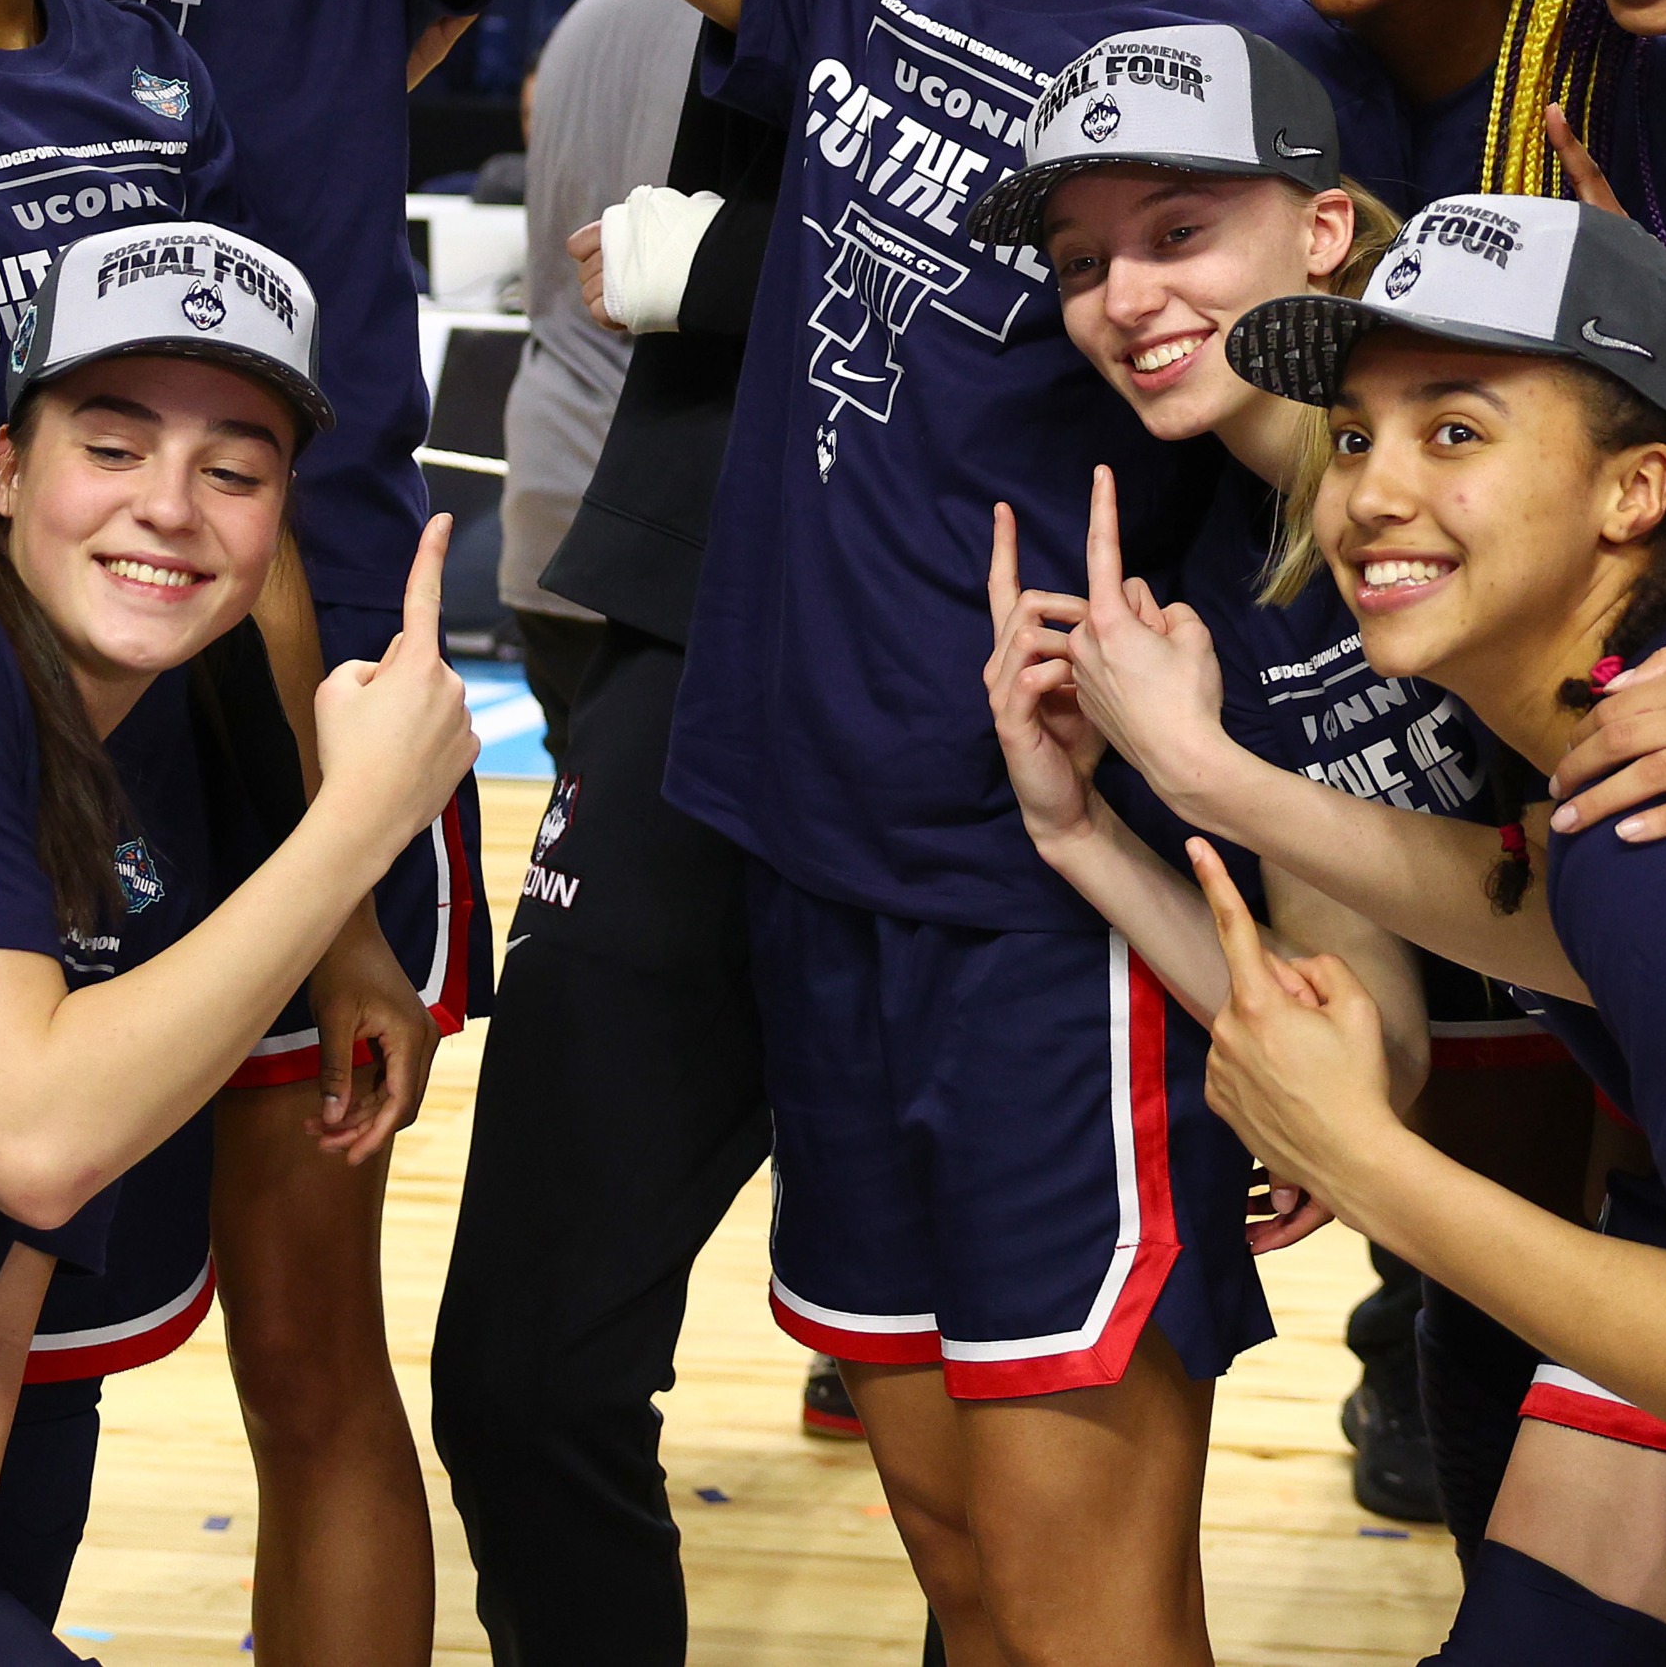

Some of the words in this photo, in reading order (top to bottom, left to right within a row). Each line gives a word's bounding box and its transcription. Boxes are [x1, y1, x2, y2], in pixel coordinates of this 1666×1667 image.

[967, 37, 1035, 81] REGIONAL
[1109, 43, 1202, 68] WOMEN'S
[1034, 63, 1099, 150] FINAL
[1106, 55, 1205, 103] FOUR
[111, 138, 188, 155] CHAMPIONS
[868, 115, 990, 237] THE
[1416, 214, 1515, 270] FOUR
[1434, 203, 1521, 235] WOMEN'S
[97, 246, 206, 300] FINAL
[213, 250, 294, 335] FOUR
[102, 239, 151, 265] 2022
[155, 235, 211, 247] NCAA
[215, 238, 293, 298] WOMEN'S
[916, 258, 941, 275] CT
